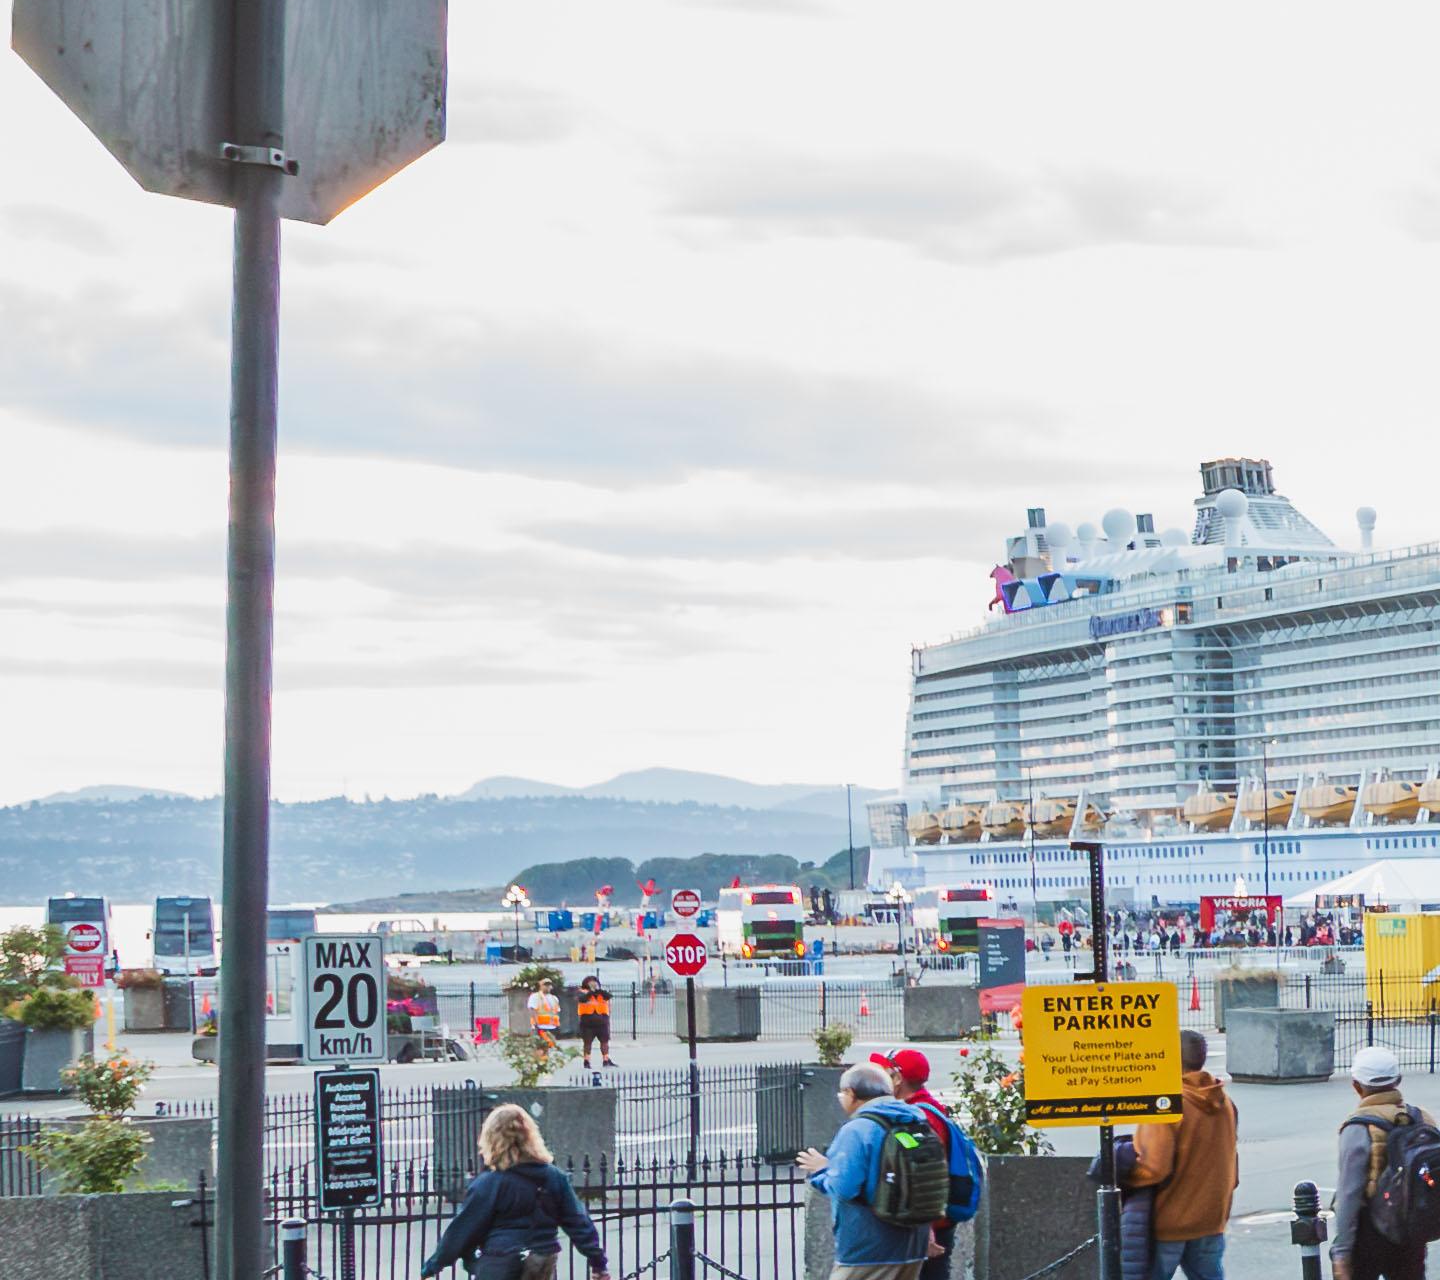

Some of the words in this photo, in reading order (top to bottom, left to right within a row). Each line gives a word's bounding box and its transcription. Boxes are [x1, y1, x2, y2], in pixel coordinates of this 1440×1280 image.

[1213, 898, 1267, 908] VICTORIA
[315, 942, 371, 968] MAX
[667, 946, 705, 964] STOP
[313, 972, 378, 1030] 20
[1043, 995, 1114, 1013] ENTER
[1120, 993, 1161, 1010] PAY
[1053, 1013, 1152, 1032] PARKING
[319, 1032, 372, 1056] km/h
[1073, 1040, 1133, 1050] Remember
[1042, 1053, 1067, 1064] Your
[1070, 1052, 1111, 1063] Licence
[1114, 1051, 1142, 1062] Plate
[1144, 1050, 1165, 1060] and
[1051, 1065, 1088, 1076] Follow
[1090, 1062, 1156, 1074] Instructions
[1066, 1078, 1078, 1086] at
[1080, 1075, 1100, 1087] Pay
[1102, 1074, 1143, 1085] Station
[328, 1124, 371, 1136] Midnight
[329, 1136, 348, 1147] and
